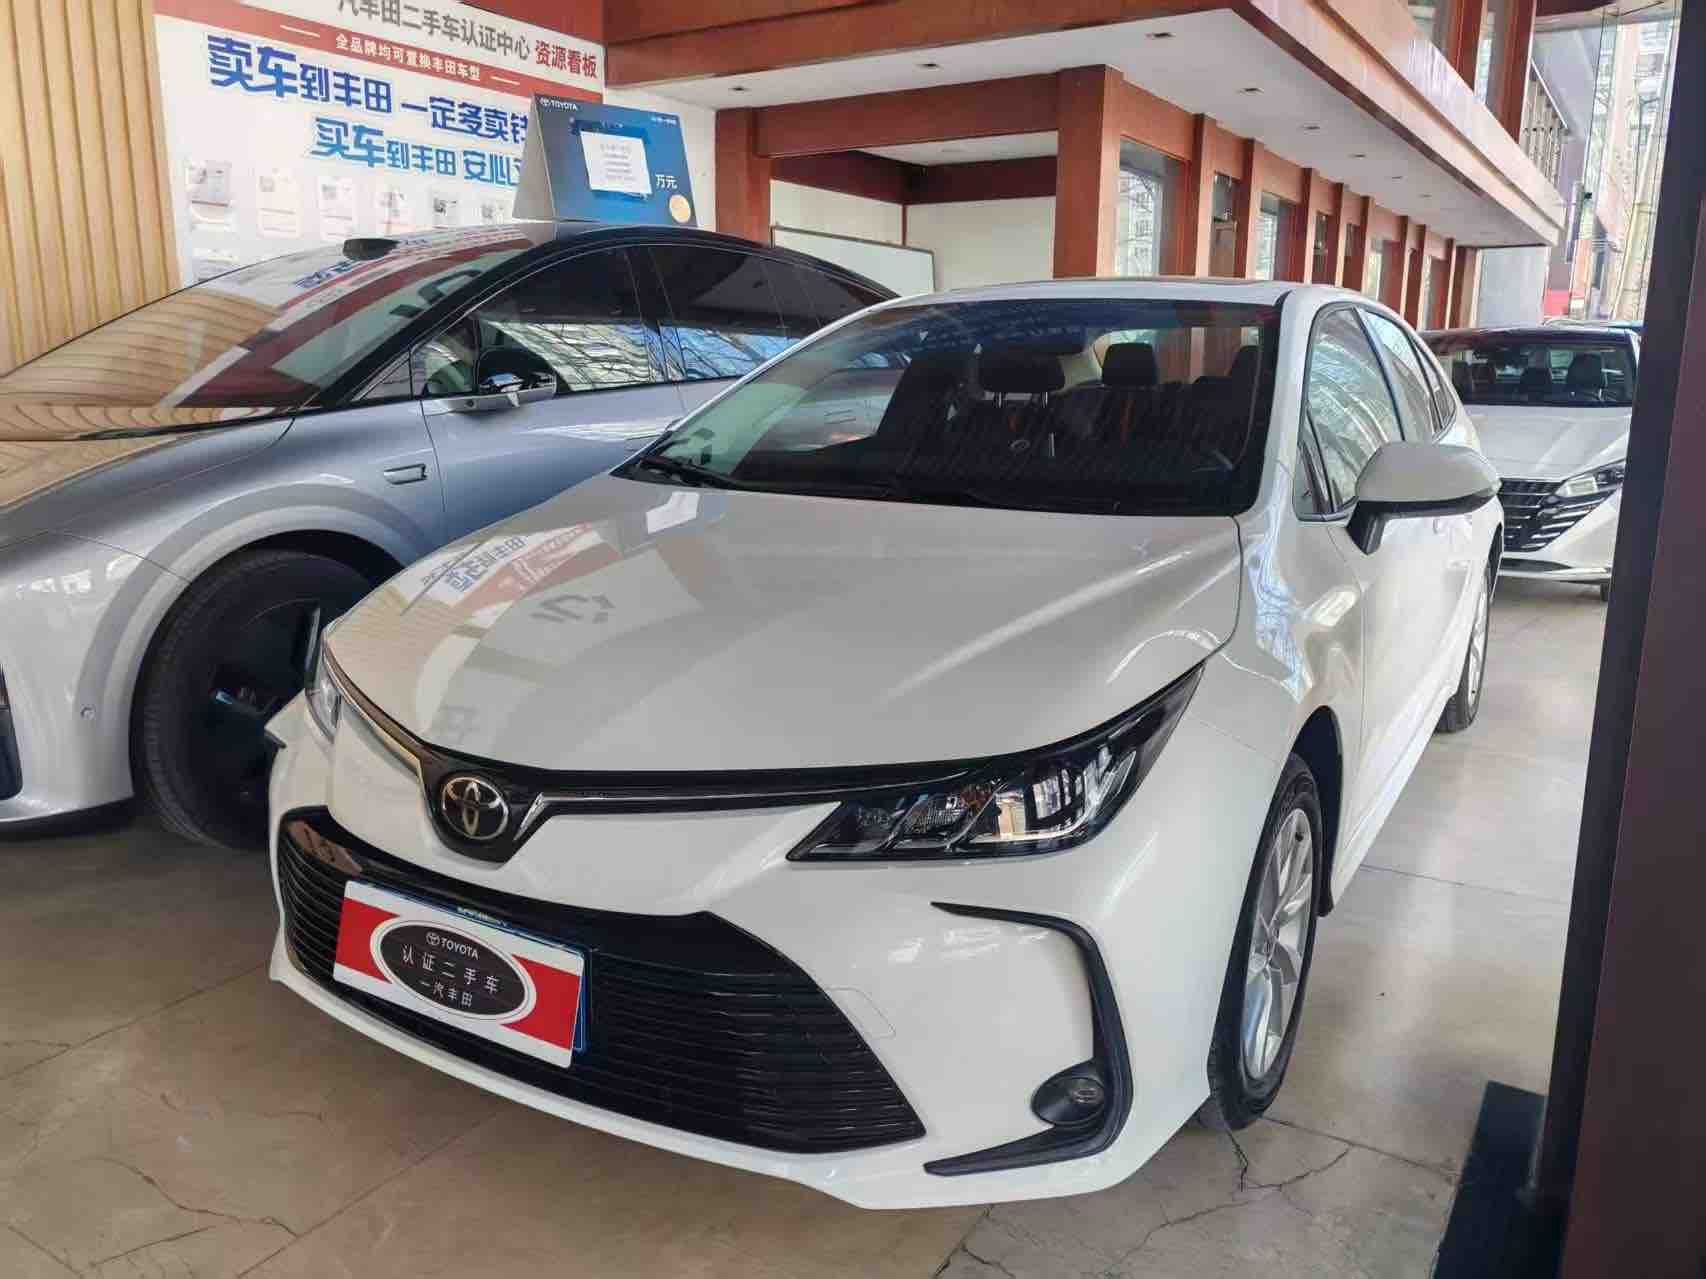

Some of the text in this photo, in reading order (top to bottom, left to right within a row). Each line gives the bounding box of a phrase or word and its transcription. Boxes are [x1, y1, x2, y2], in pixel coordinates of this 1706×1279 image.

[207, 35, 393, 114] 卖车到丰田
[335, 33, 481, 82] 全品牌均可置换丰田车型
[535, 39, 598, 79] 资源看板
[550, 99, 577, 110] TOYOTA
[310, 116, 522, 187] 买车到丰田 安心
[655, 173, 678, 190] 万元
[440, 936, 480, 961] TOYOTA
[402, 944, 499, 995] 认证二手车
[420, 981, 473, 1008] 一汽丰田
